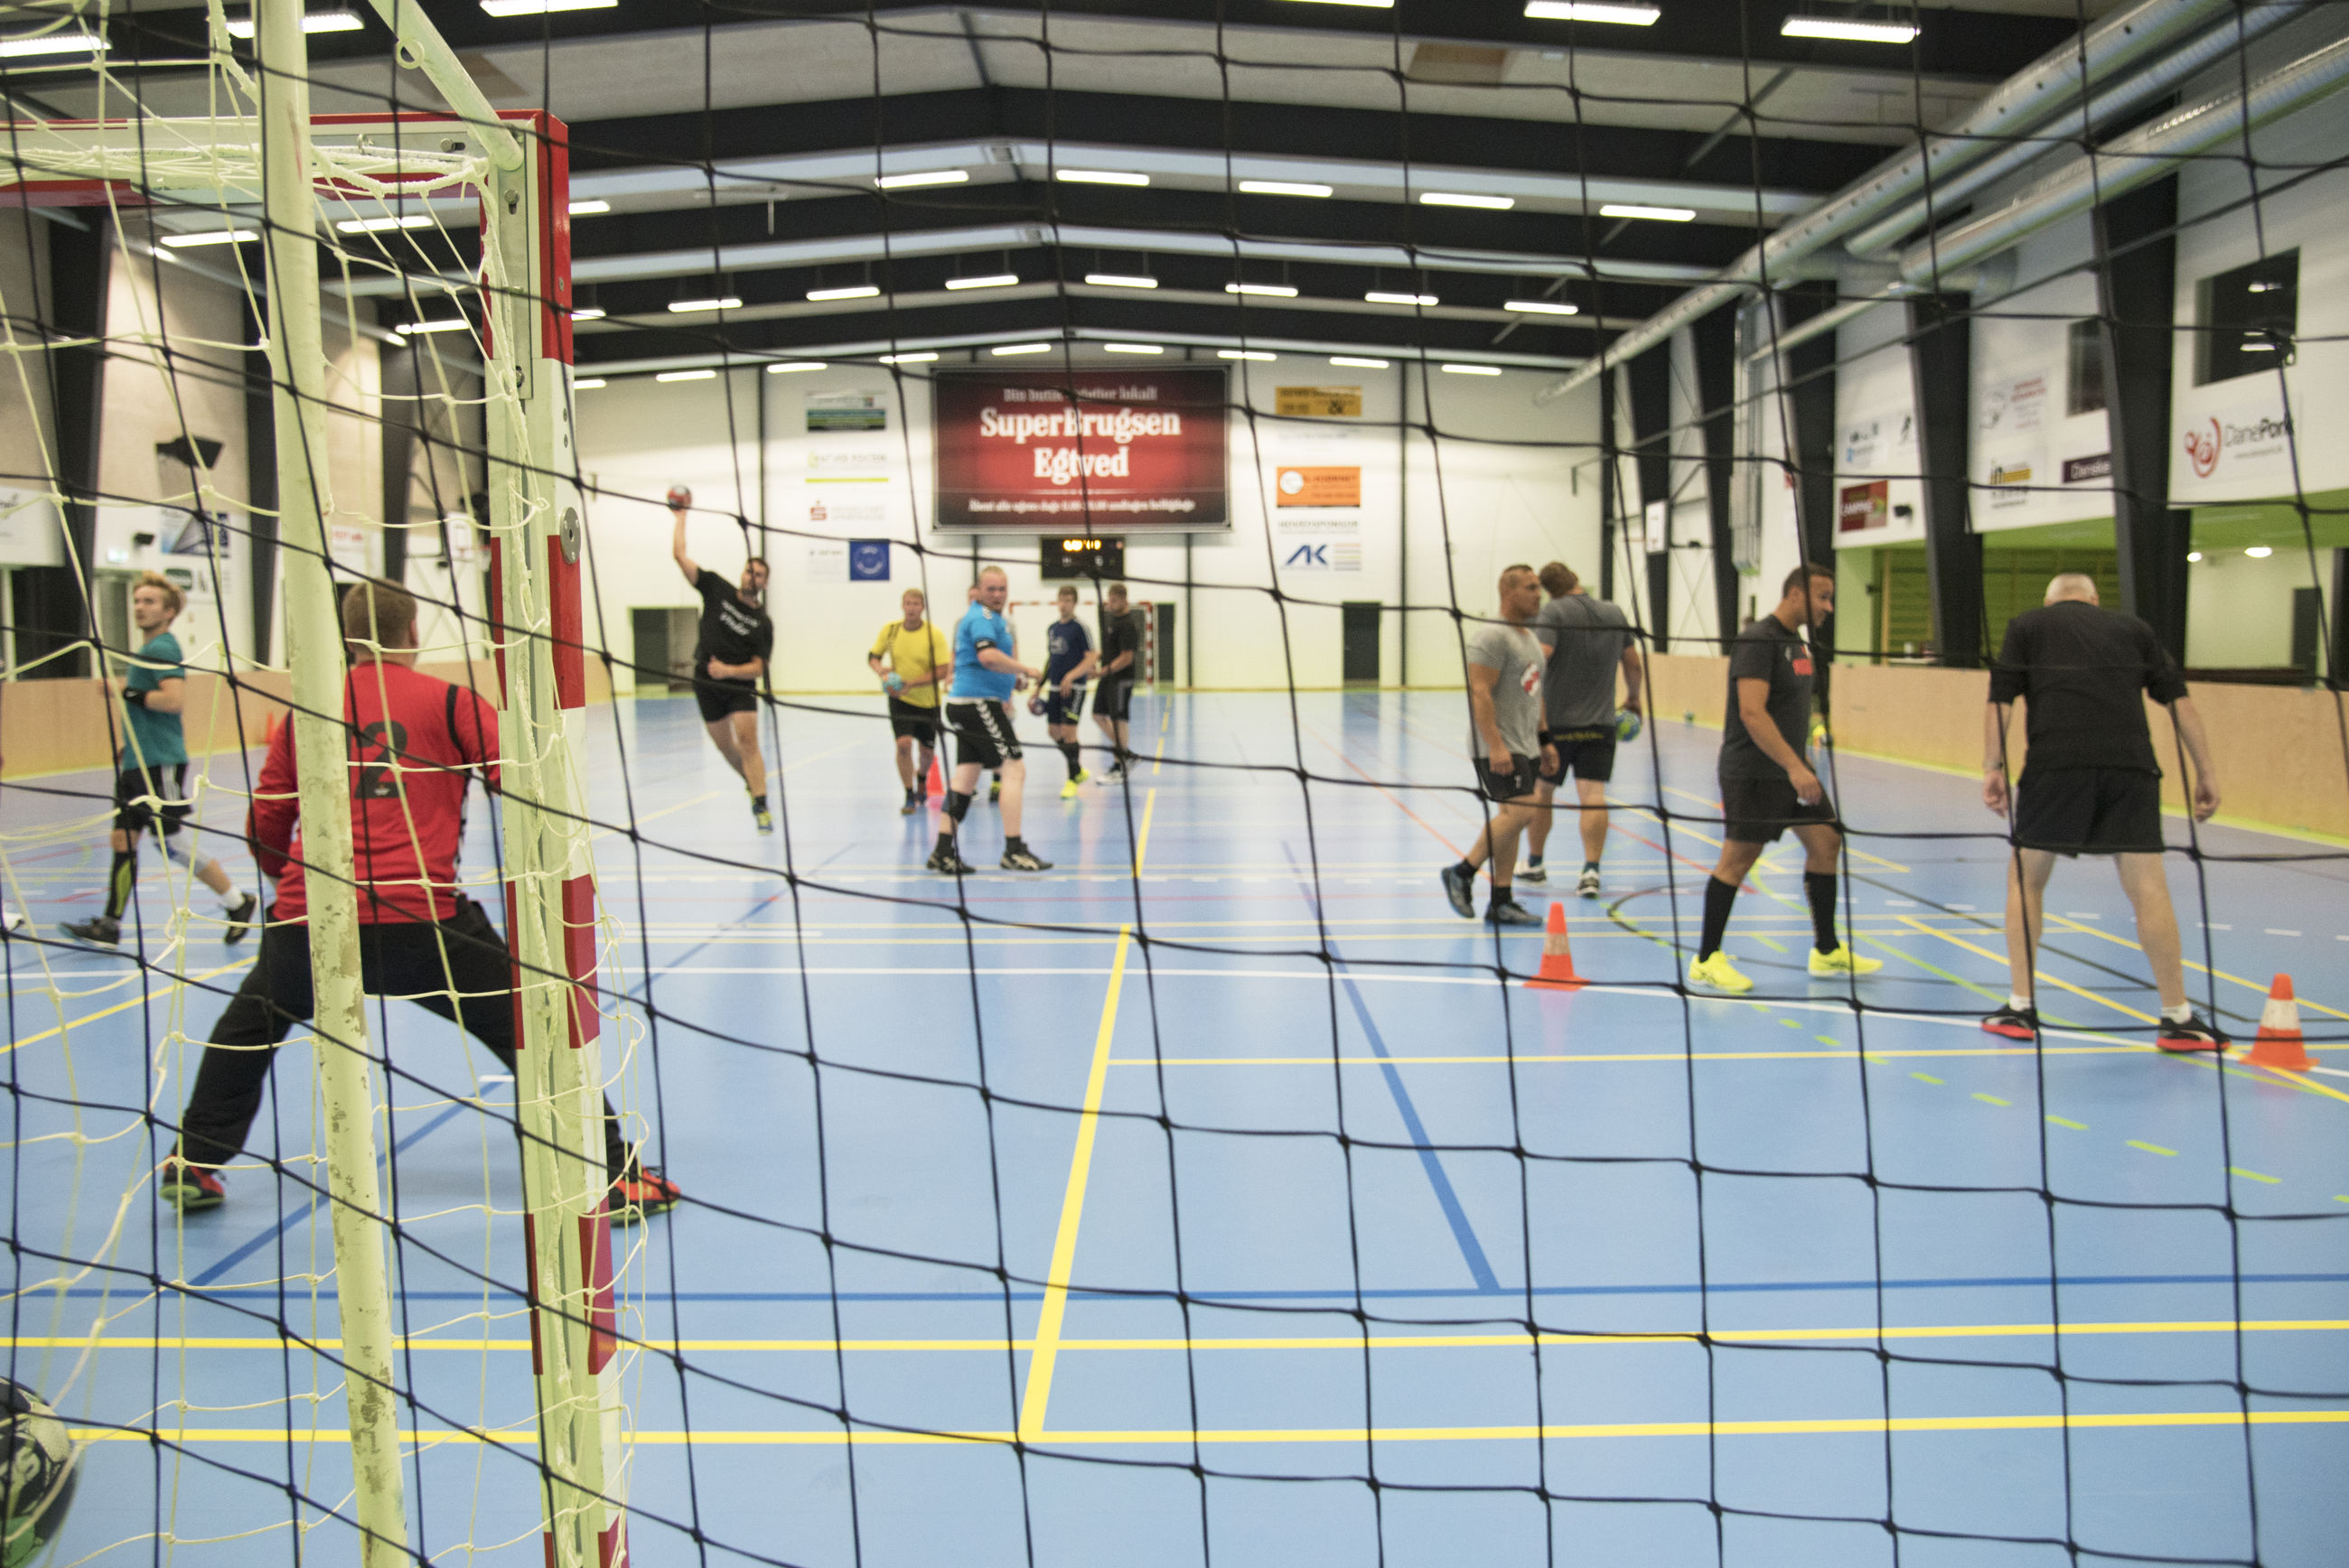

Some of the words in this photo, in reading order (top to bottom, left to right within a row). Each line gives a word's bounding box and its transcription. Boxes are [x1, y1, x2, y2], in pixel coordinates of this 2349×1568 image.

[980, 406, 1182, 444] SuperBrugsen
[1034, 445, 1130, 485] Egtved
[344, 720, 407, 799] 2
